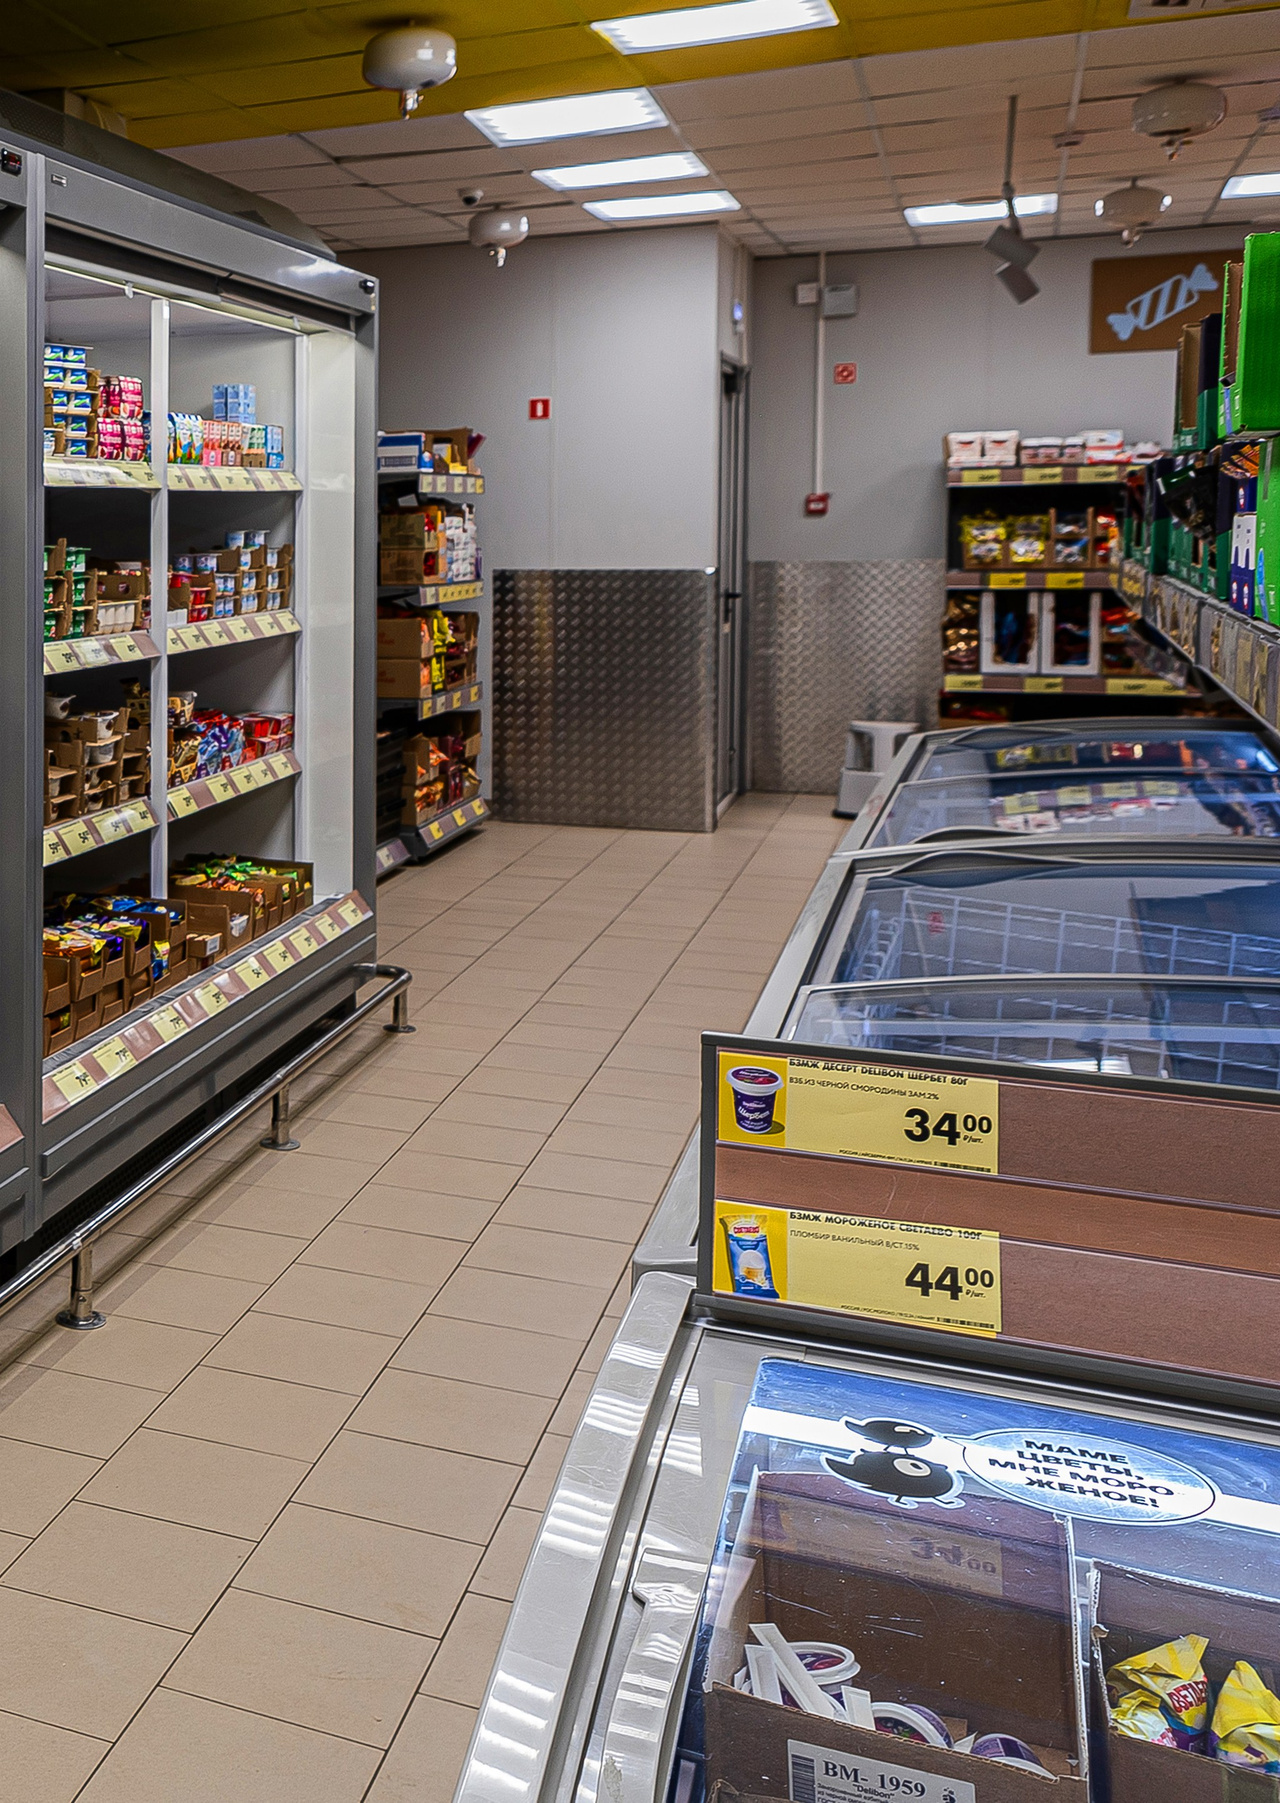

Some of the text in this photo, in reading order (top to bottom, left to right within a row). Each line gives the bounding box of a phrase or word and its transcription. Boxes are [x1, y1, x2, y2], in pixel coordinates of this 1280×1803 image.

[789, 1058, 820, 1069] БЗМЖ
[822, 1062, 858, 1073] ДЕСЕРТ
[907, 1071, 948, 1084] ШЕРБЕТ
[950, 1075, 969, 1086] 80Г
[816, 1080, 850, 1090] ЧЕРНОЙ
[850, 1084, 907, 1097] СМОРОДИНЫ
[789, 1211, 822, 1223] БЗМЖ
[825, 1216, 896, 1231] МОРОЖЕНОЕ
[899, 1224, 953, 1238] СВЕТАЕВО
[790, 1230, 830, 1241] ПЛОМБИР
[832, 1234, 884, 1247] ВАНИЛЬНЫЙ
[1017, 1450, 1144, 1480] ЦВЕТЫ,
[1025, 1440, 1129, 1465] МАМЕ
[989, 1458, 1174, 1496] МНЕ МОРО
[1026, 1477, 1160, 1508] ЖЕНОЕ!
[877, 1774, 926, 1798] 1959
